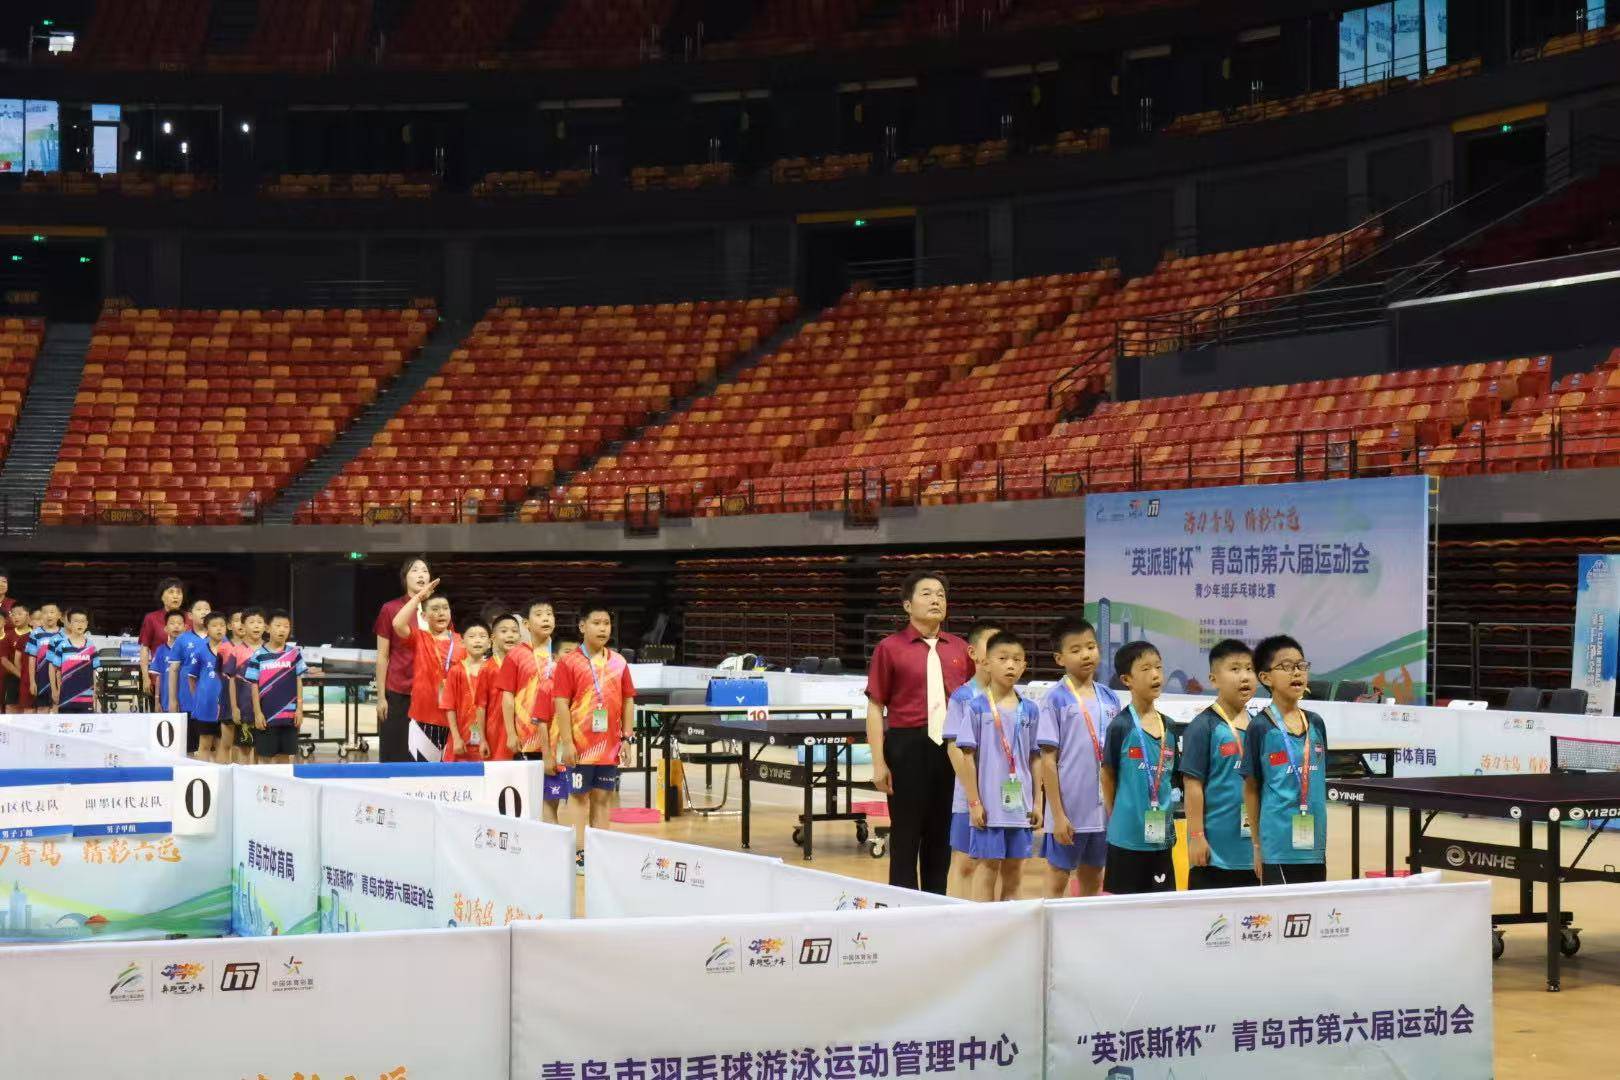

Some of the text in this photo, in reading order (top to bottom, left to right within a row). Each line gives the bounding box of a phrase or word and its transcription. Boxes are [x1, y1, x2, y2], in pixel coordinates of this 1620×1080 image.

[1211, 542, 1370, 575] 青岛市第六届运动会
[1194, 583, 1276, 599] 青少年组乒乓球比赛
[156, 720, 175, 748] 0
[572, 773, 583, 789] 18
[85, 795, 163, 809] 即墨区代表队
[185, 778, 211, 819] 0
[1338, 791, 1365, 801] YINHE
[106, 824, 136, 833] 男子甲组
[247, 840, 295, 882] 青岛市体育局
[1467, 850, 1517, 870] YINHE
[360, 875, 434, 911] 青岛市第六届运动会
[1232, 1003, 1474, 1052] 青岛市第六届运动会
[541, 1033, 1019, 1080] 青岛市羽毛球游泳运动管理中心
